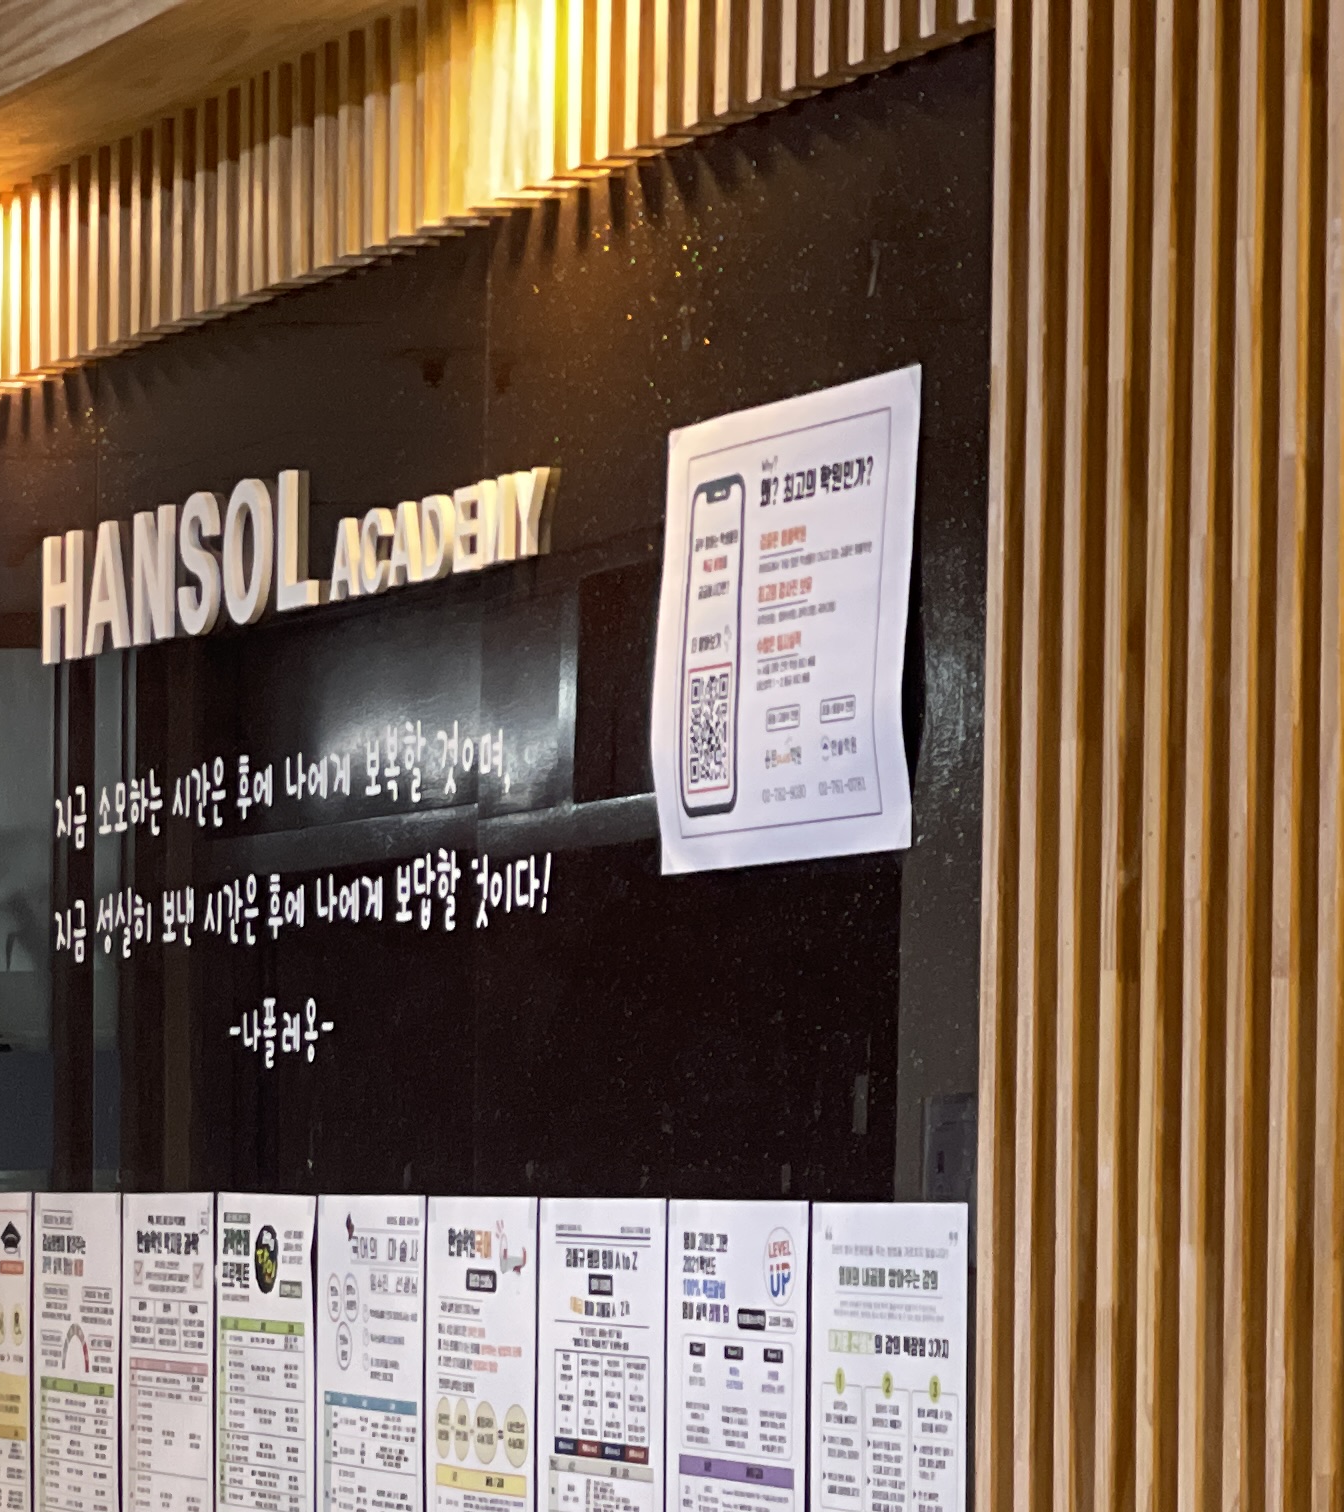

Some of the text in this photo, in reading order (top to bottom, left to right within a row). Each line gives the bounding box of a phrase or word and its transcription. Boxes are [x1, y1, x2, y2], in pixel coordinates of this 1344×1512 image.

[783, 468, 818, 503] 최고의
[820, 456, 875, 494] 학원인가?
[42, 467, 556, 665] HANSOL ACADEMY
[55, 785, 87, 849] 지금
[98, 768, 163, 836] 소모하는
[172, 756, 226, 827] 시간은
[237, 755, 273, 820] 후에
[285, 752, 351, 800] 나에게
[365, 720, 427, 803] 보복할
[54, 899, 87, 963] 지금
[96, 887, 152, 959] 성실히
[162, 886, 194, 946] 보낸
[204, 873, 259, 945] 시간은
[268, 873, 305, 940] 후에
[316, 873, 383, 923] 나에게
[395, 847, 461, 931] 보답할
[768, 1240, 791, 1259] LEVEL
[770, 1262, 791, 1297] UP
